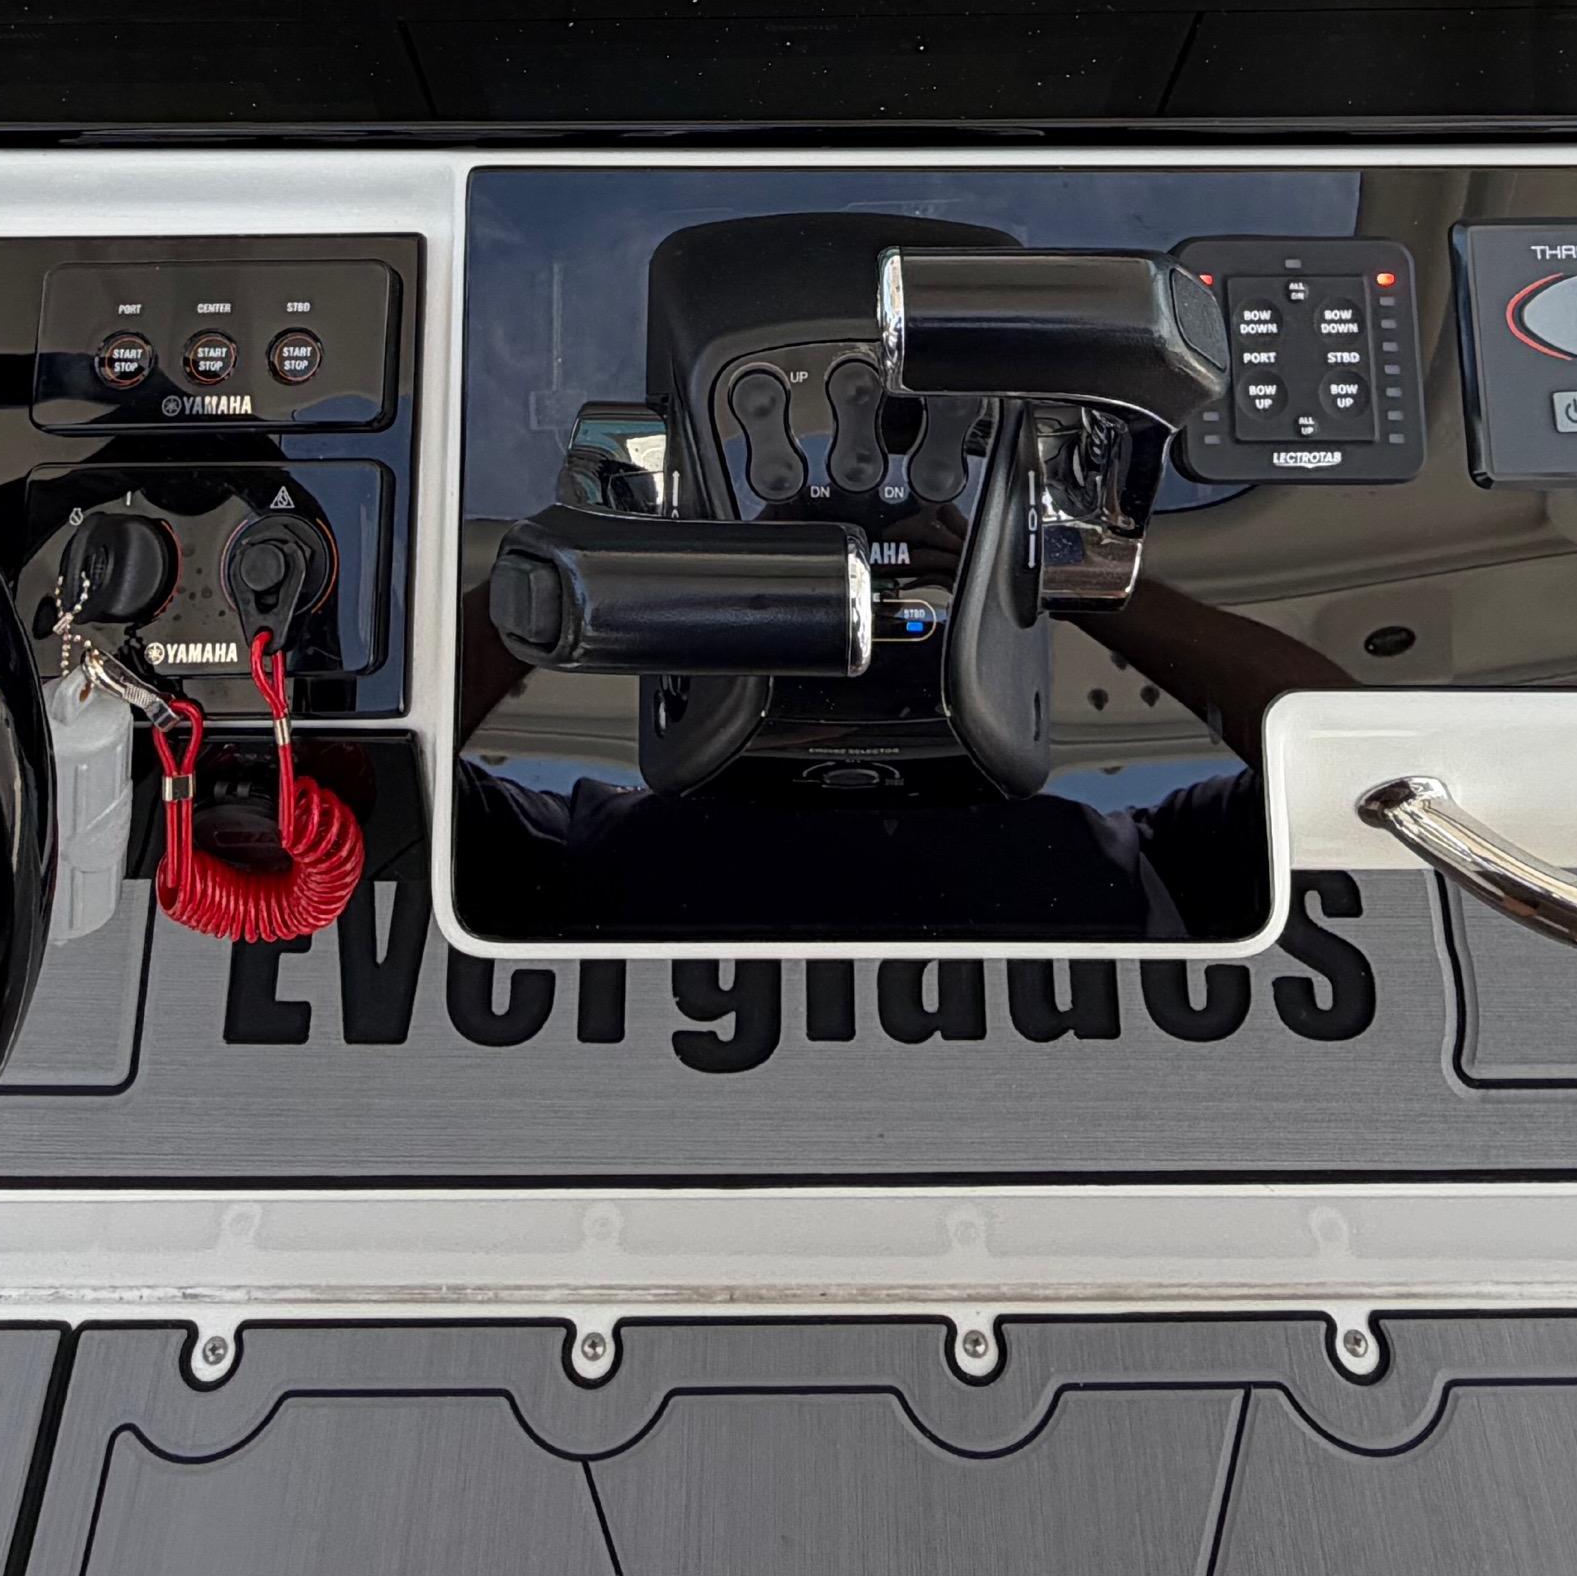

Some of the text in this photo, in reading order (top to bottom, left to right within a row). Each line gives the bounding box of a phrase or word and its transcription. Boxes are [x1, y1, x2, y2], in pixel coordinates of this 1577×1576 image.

[1289, 282, 1305, 290] ALL
[118, 304, 142, 315] PORT
[197, 303, 232, 313] CENTER
[287, 302, 311, 312] STBD
[1243, 310, 1272, 320] BOW
[1324, 309, 1353, 320] BOW
[1240, 324, 1278, 334] DOWN
[1321, 323, 1359, 333] DOWN
[113, 349, 142, 359] START
[197, 348, 227, 357] START
[282, 347, 312, 357] START
[1243, 352, 1277, 363] PORT
[1327, 352, 1360, 363] STBD
[114, 362, 138, 372] STOP
[198, 361, 223, 371] STOP
[283, 360, 308, 370] STOP
[790, 372, 809, 383] UP
[1248, 385, 1277, 395] BOW
[1330, 384, 1358, 395] BOW
[183, 396, 252, 414] YAMAHA
[1255, 399, 1273, 409] UP
[1337, 398, 1354, 408] UP
[1298, 417, 1315, 425] ALL
[1301, 427, 1314, 435] UP
[1273, 452, 1342, 465] LECTROTAB
[811, 486, 830, 498] DN
[884, 487, 904, 498] DN
[166, 642, 238, 663] YAMAHA
